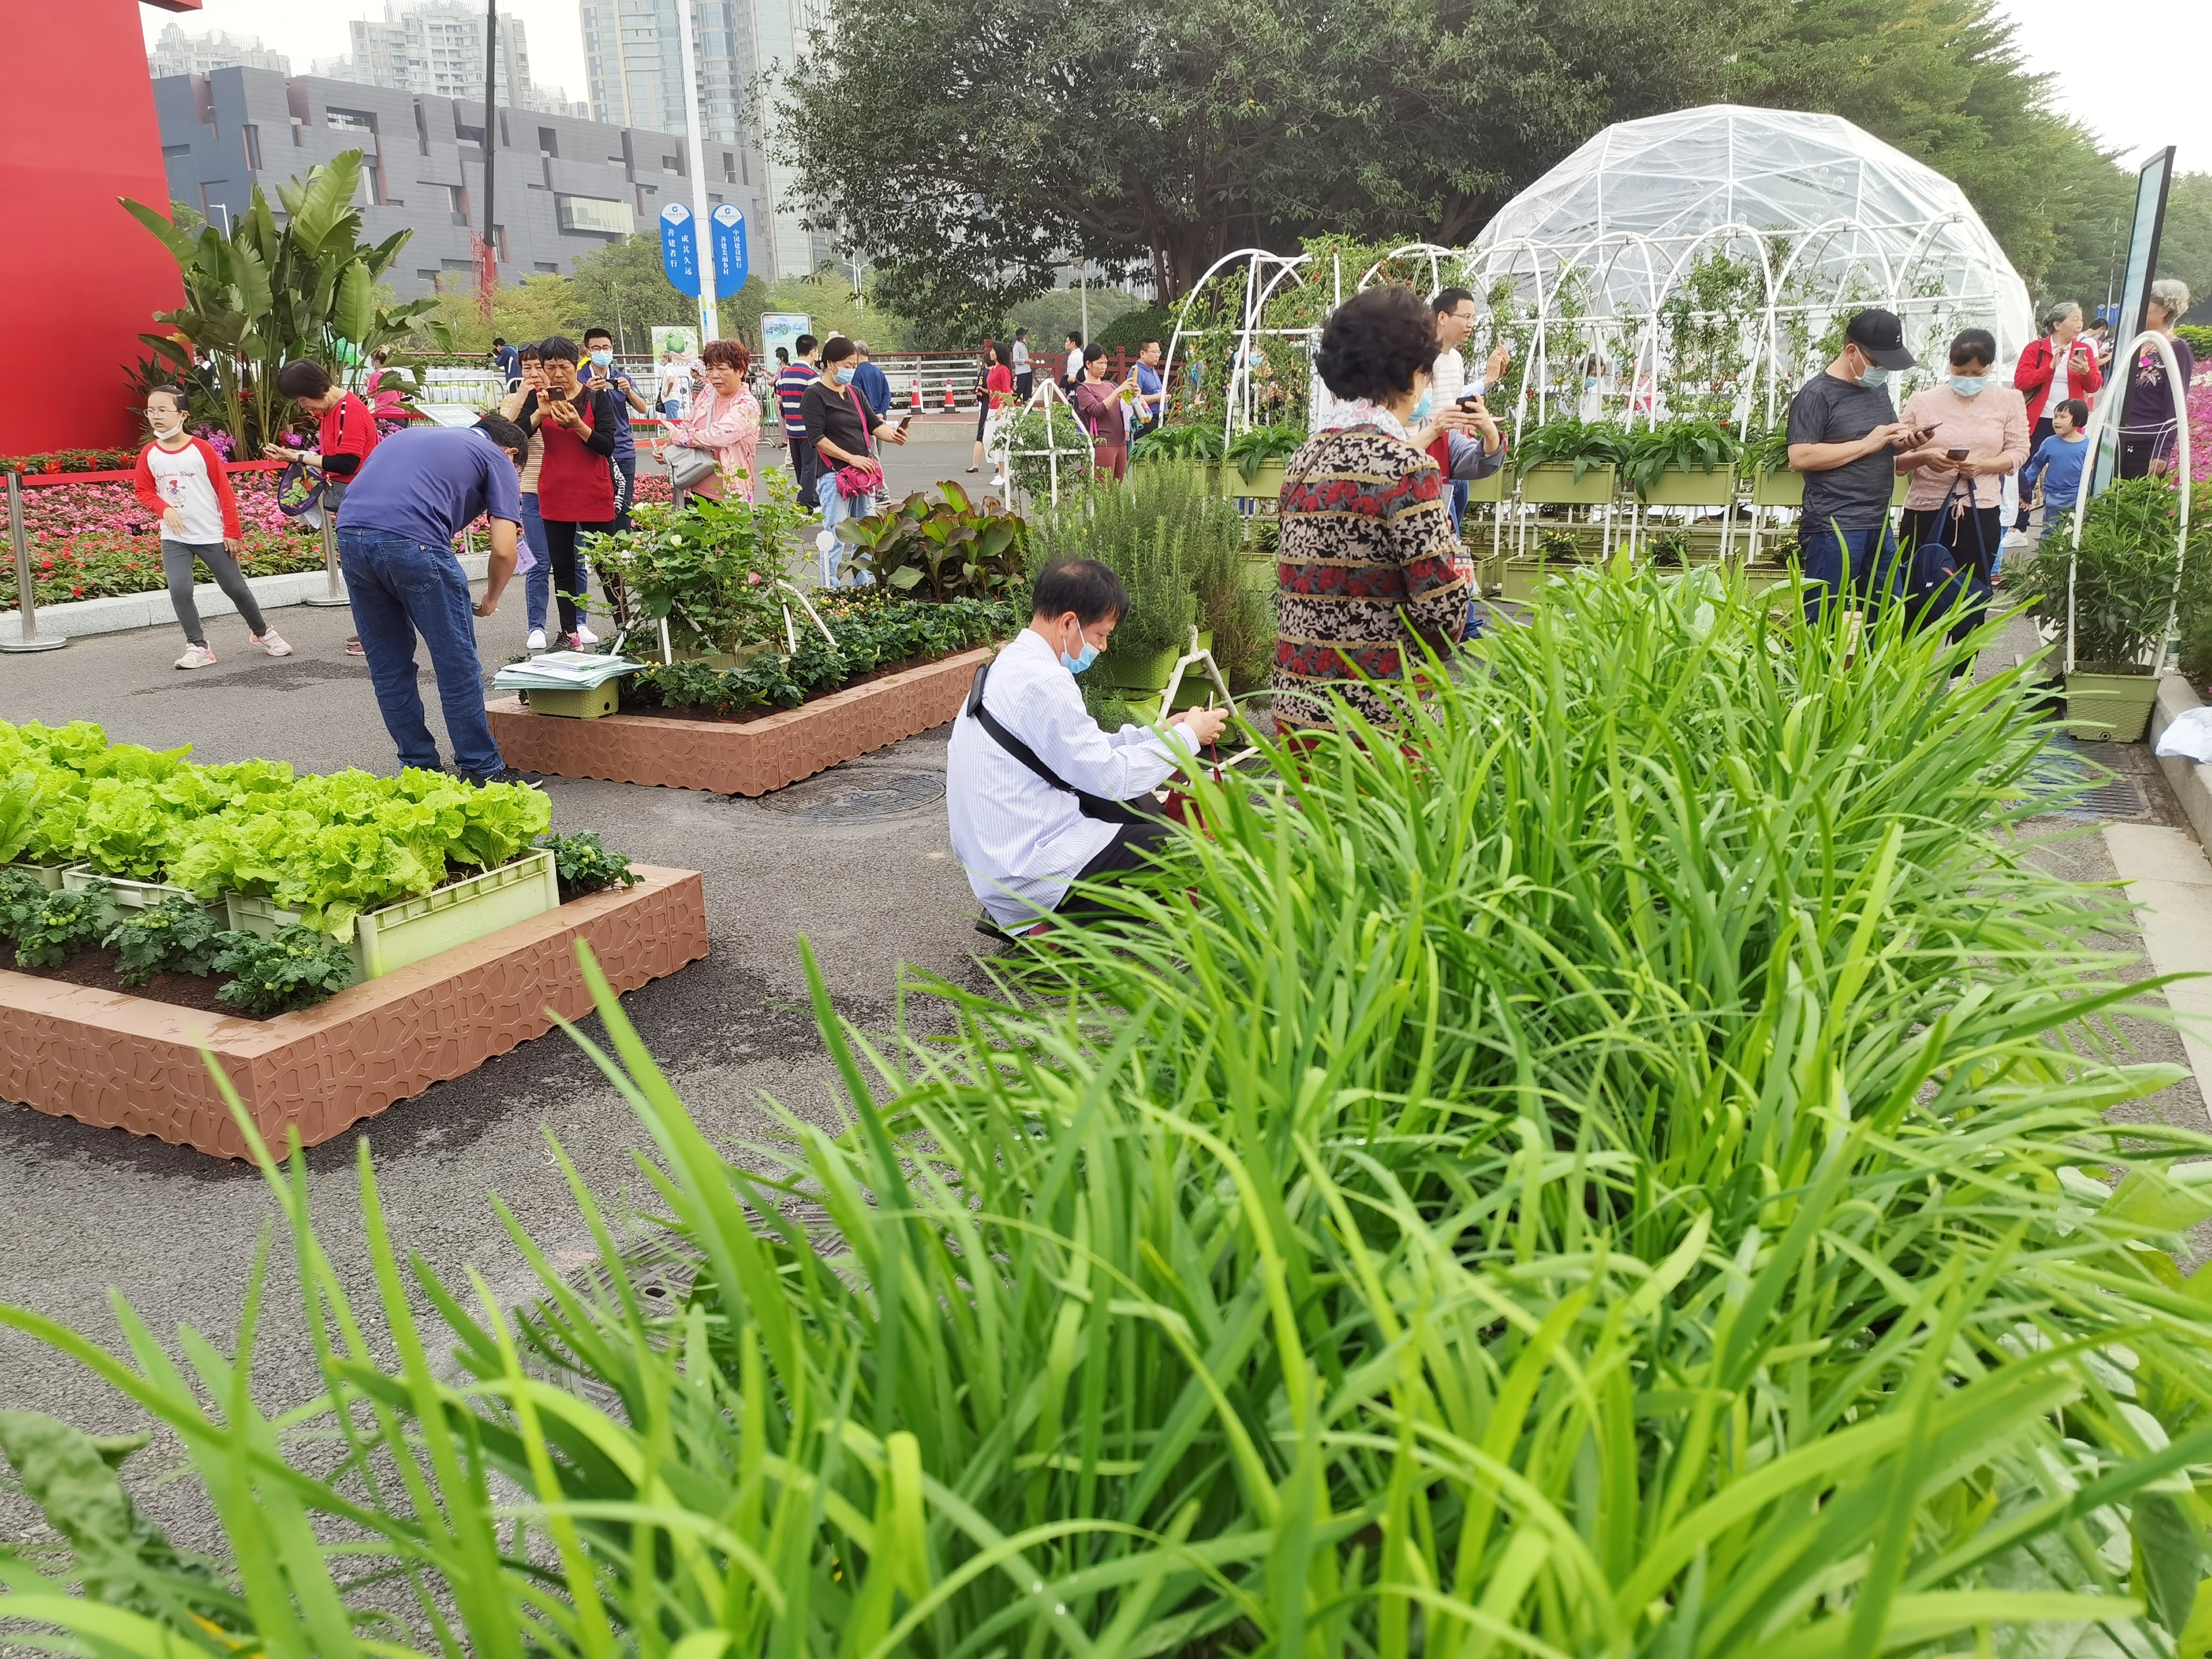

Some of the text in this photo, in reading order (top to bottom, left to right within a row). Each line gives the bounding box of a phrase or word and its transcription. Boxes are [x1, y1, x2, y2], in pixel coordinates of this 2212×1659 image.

[667, 228, 678, 268] 善建者行
[681, 234, 692, 275] 成其久远
[720, 235, 729, 275] 善建美丽乡村
[732, 228, 742, 269] 中国建设银行
